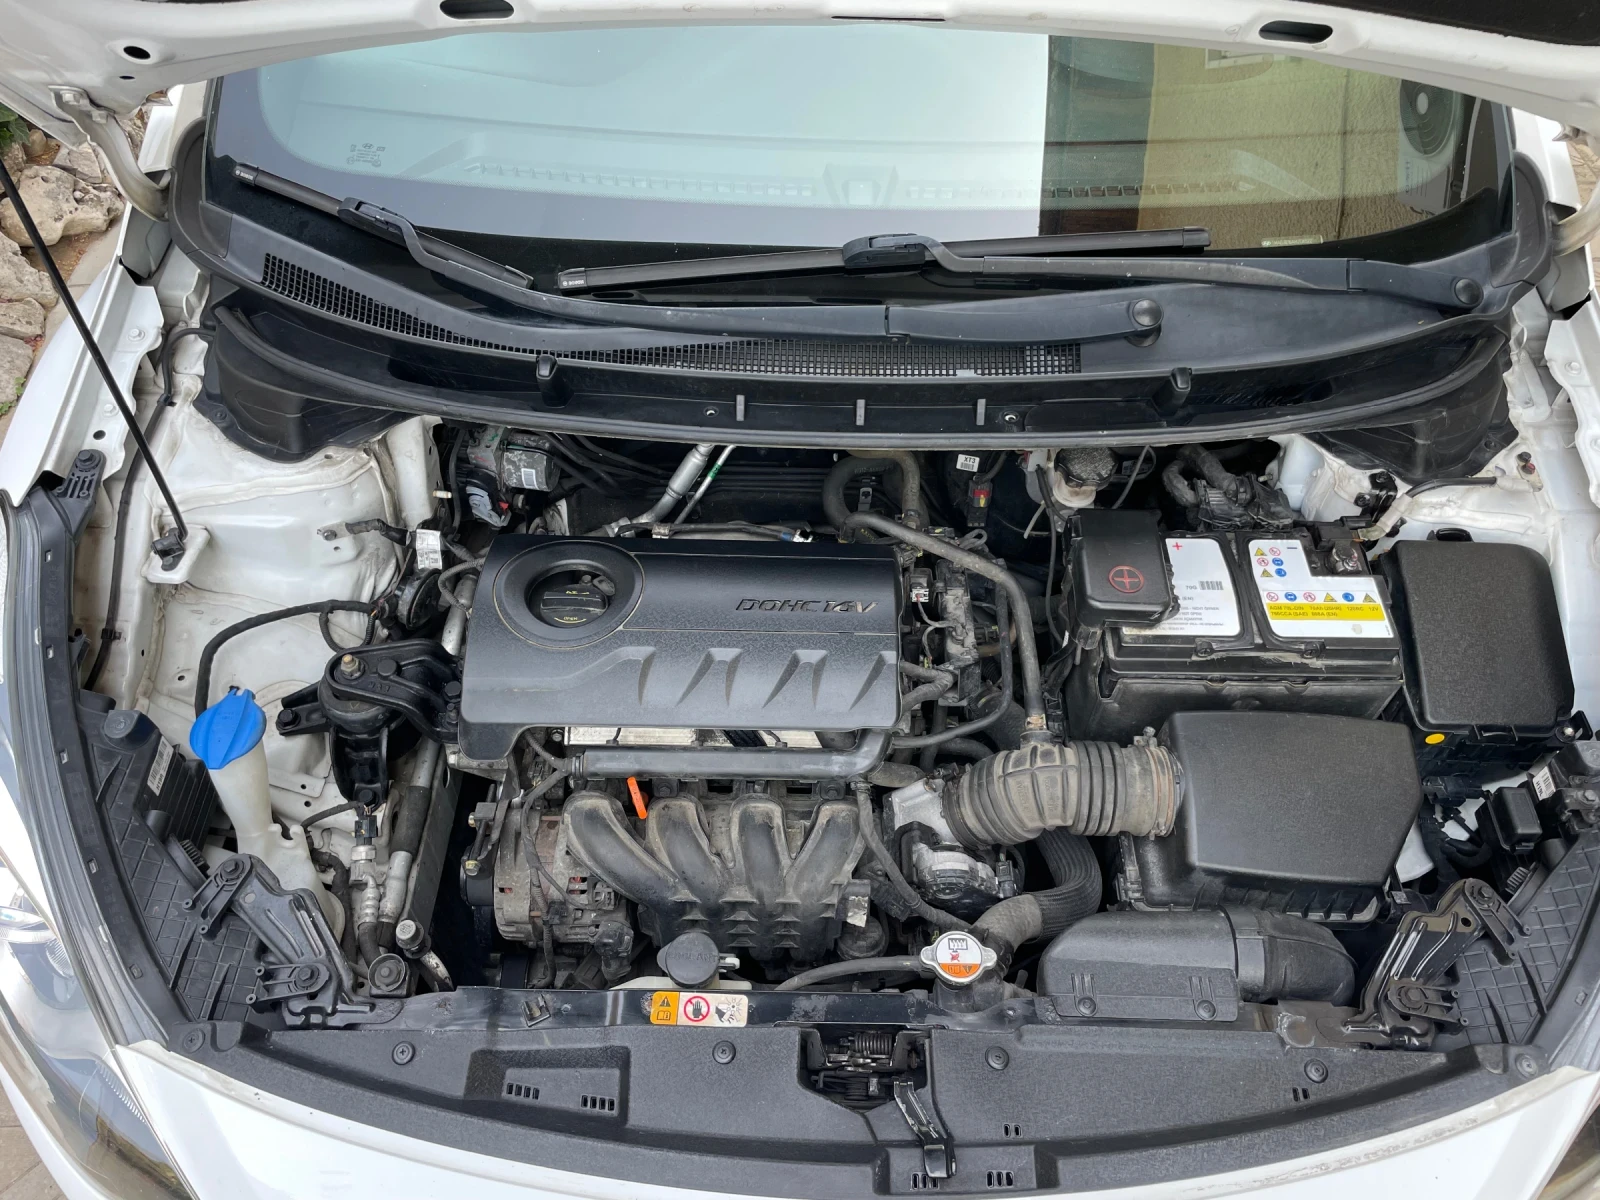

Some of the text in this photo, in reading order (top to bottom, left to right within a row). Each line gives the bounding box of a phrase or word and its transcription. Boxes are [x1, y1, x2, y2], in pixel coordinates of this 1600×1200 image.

[963, 456, 976, 464] XT3
[735, 598, 878, 614] DOHC 16V
